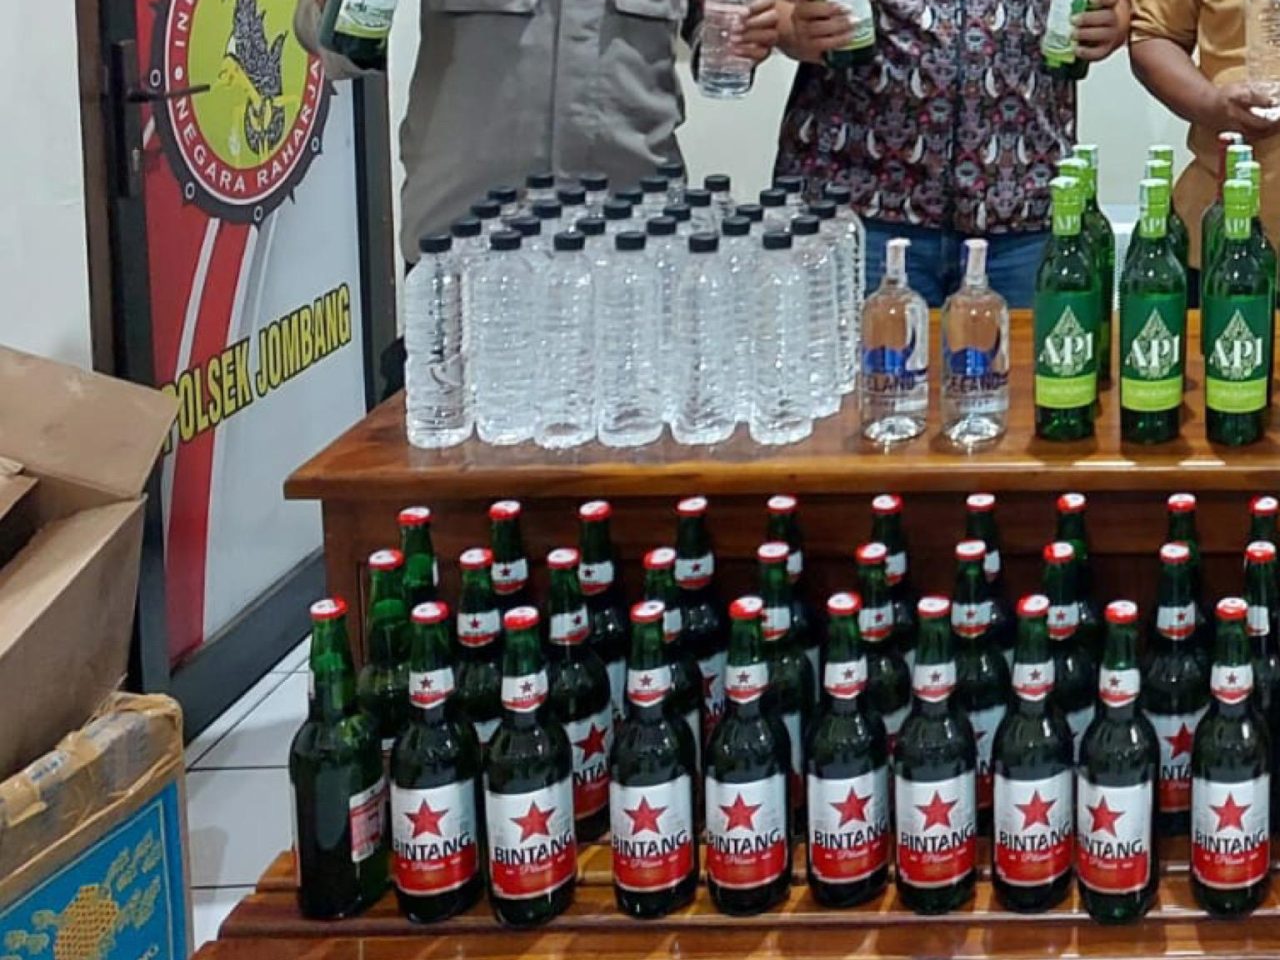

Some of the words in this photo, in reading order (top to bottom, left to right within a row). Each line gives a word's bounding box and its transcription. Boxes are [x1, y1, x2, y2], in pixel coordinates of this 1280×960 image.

[174, 99, 246, 193] NEGARA
[256, 59, 321, 188] RAHARJA
[255, 282, 351, 398] JOMBANG
[492, 830, 572, 866] BINTANG
[612, 829, 688, 860] BINTANG
[814, 817, 888, 849] BINTANG
[901, 822, 976, 854] BINTANG
[999, 820, 1072, 851] BINTANG
